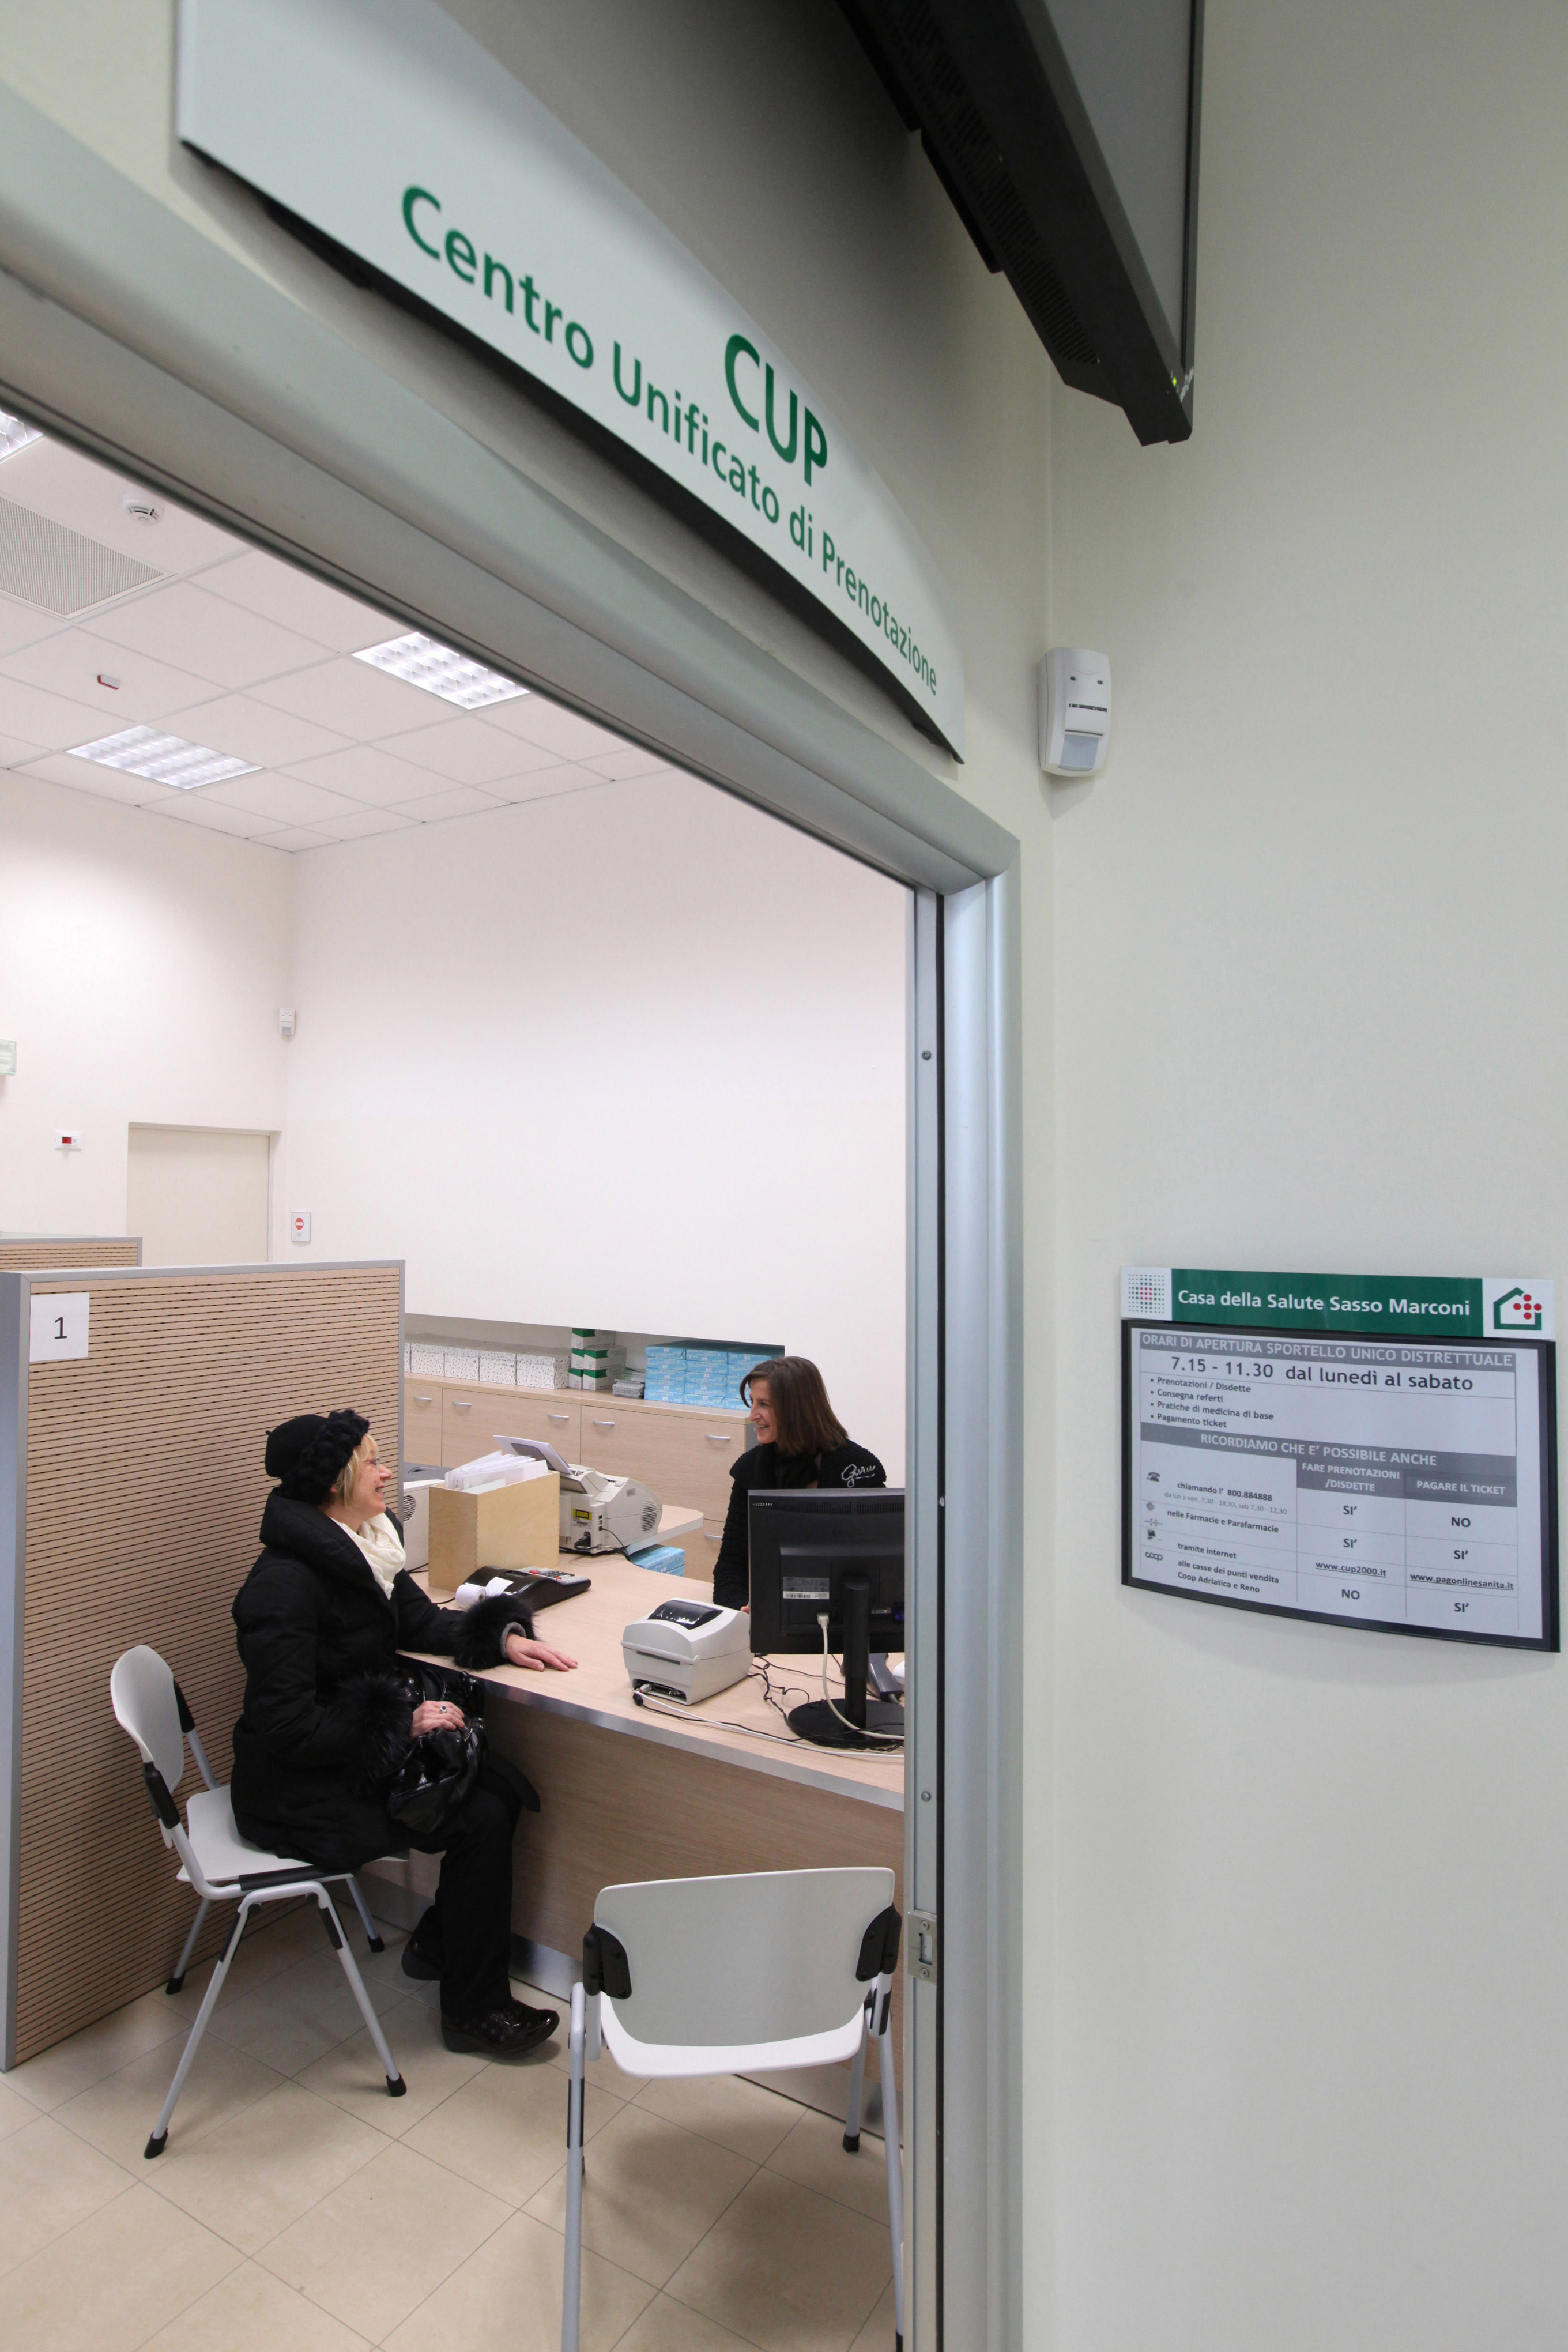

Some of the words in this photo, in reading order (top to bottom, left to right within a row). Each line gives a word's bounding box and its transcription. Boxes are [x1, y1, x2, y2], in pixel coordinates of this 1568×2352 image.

[725, 333, 828, 487] CUP
[402, 184, 594, 369] Centro
[613, 340, 779, 524] Unificato
[789, 504, 813, 559] di
[822, 530, 937, 696] Prenotazione
[1178, 1290, 1216, 1305] Casa
[1220, 1291, 1262, 1307] della
[1267, 1294, 1324, 1311] Salute
[1329, 1296, 1383, 1313] Sasso
[1389, 1298, 1471, 1316] Marconi
[54, 1316, 68, 1340] 1
[1143, 1334, 1177, 1347] ORARI
[1181, 1337, 1193, 1348] DI
[1196, 1338, 1262, 1353] APERTURA
[1267, 1343, 1346, 1358] SPORTELLO
[1351, 1348, 1396, 1361] UNICO
[1401, 1350, 1512, 1366] DISTRETTUALE
[1171, 1356, 1206, 1372] 7.15
[1226, 1362, 1273, 1377] 11.30
[1286, 1366, 1312, 1381] dal
[1320, 1367, 1377, 1385] lunedì
[1385, 1372, 1401, 1386] al
[1409, 1374, 1473, 1390] sabato
[1157, 1377, 1208, 1389] Prenotazioni
[1216, 1382, 1251, 1392] Disdette
[1157, 1389, 1194, 1401] Consegna
[1196, 1393, 1223, 1403] referti
[1157, 1401, 1190, 1411] Pratiche
[1192, 1404, 1200, 1412] di
[1203, 1407, 1240, 1417] medicina
[1243, 1410, 1251, 1418] di
[1254, 1411, 1274, 1420] base
[1157, 1413, 1200, 1425] Pagamento
[1203, 1418, 1227, 1428] ticket
[1201, 1433, 1278, 1453] RICORDIAMO
[1281, 1440, 1306, 1454] CHE
[1323, 1446, 1386, 1463] POSSIBILE
[1390, 1452, 1437, 1466] ANCHE
[1302, 1463, 1325, 1473] FARE
[1328, 1465, 1400, 1480] PRENOTAZIONI
[1177, 1482, 1217, 1494] chiamando
[1227, 1489, 1273, 1502] 800.884888
[1325, 1479, 1375, 1492] /DISDETTE
[1416, 1480, 1457, 1492] PAGARE
[1460, 1483, 1469, 1492] IL
[1471, 1484, 1506, 1495] TICKET
[1167, 1510, 1185, 1519] nelle
[1186, 1512, 1219, 1525] Farmacie
[1227, 1519, 1279, 1533] Parafarmacie
[1451, 1517, 1471, 1528] NO
[1178, 1543, 1205, 1554] tramite
[1206, 1547, 1237, 1559] internet
[1178, 1559, 1191, 1568] alle
[1192, 1564, 1212, 1573] casse
[1213, 1566, 1226, 1575] dei
[1227, 1569, 1247, 1578] punti
[1249, 1573, 1279, 1584] vendita
[1316, 1561, 1387, 1578] www.cup2000.it
[1178, 1571, 1196, 1582] Coop
[1198, 1575, 1231, 1588] Adriatica
[1240, 1583, 1260, 1593] Reno
[1410, 1573, 1514, 1590] www.pagonlinesanita.it
[1341, 1589, 1360, 1600] NO
